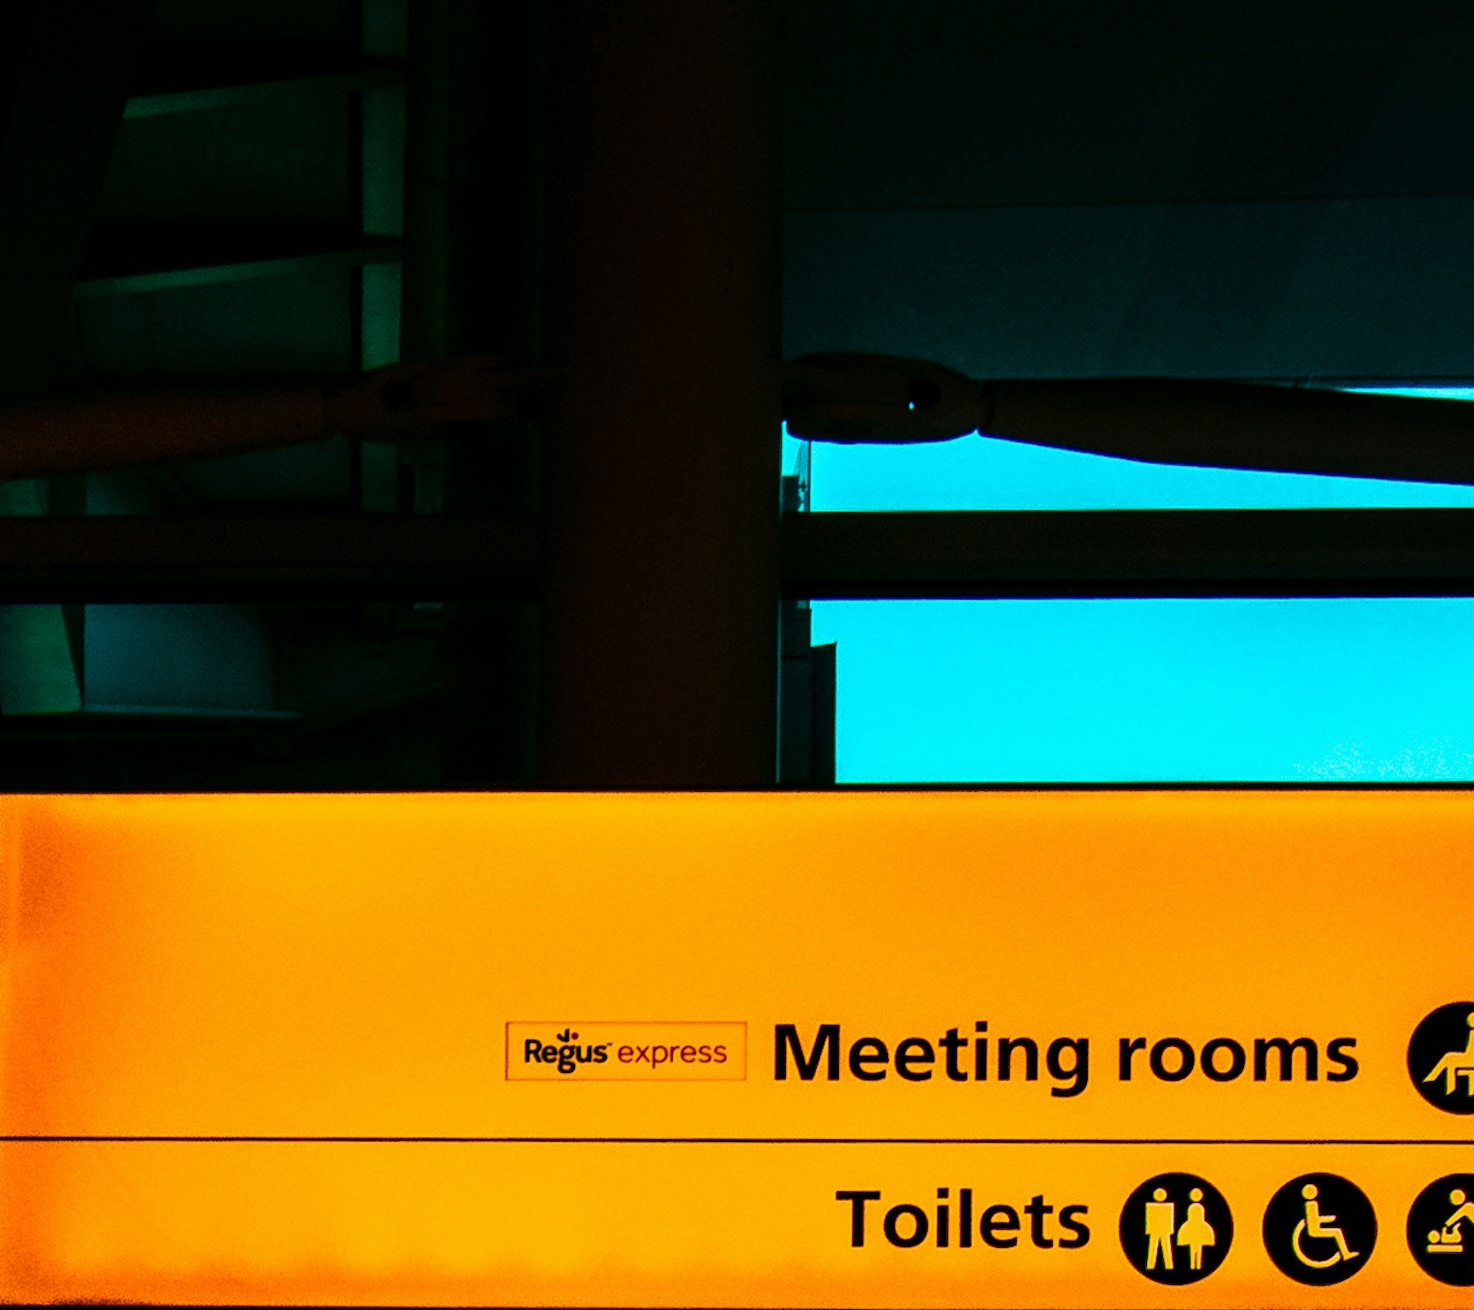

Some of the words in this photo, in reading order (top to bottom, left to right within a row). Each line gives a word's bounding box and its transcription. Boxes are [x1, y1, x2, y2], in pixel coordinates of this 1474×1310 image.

[616, 1044, 728, 1070] express
[774, 1021, 1089, 1098] Meeting
[1119, 1037, 1359, 1082] rooms
[835, 1187, 1090, 1249] Toilets
